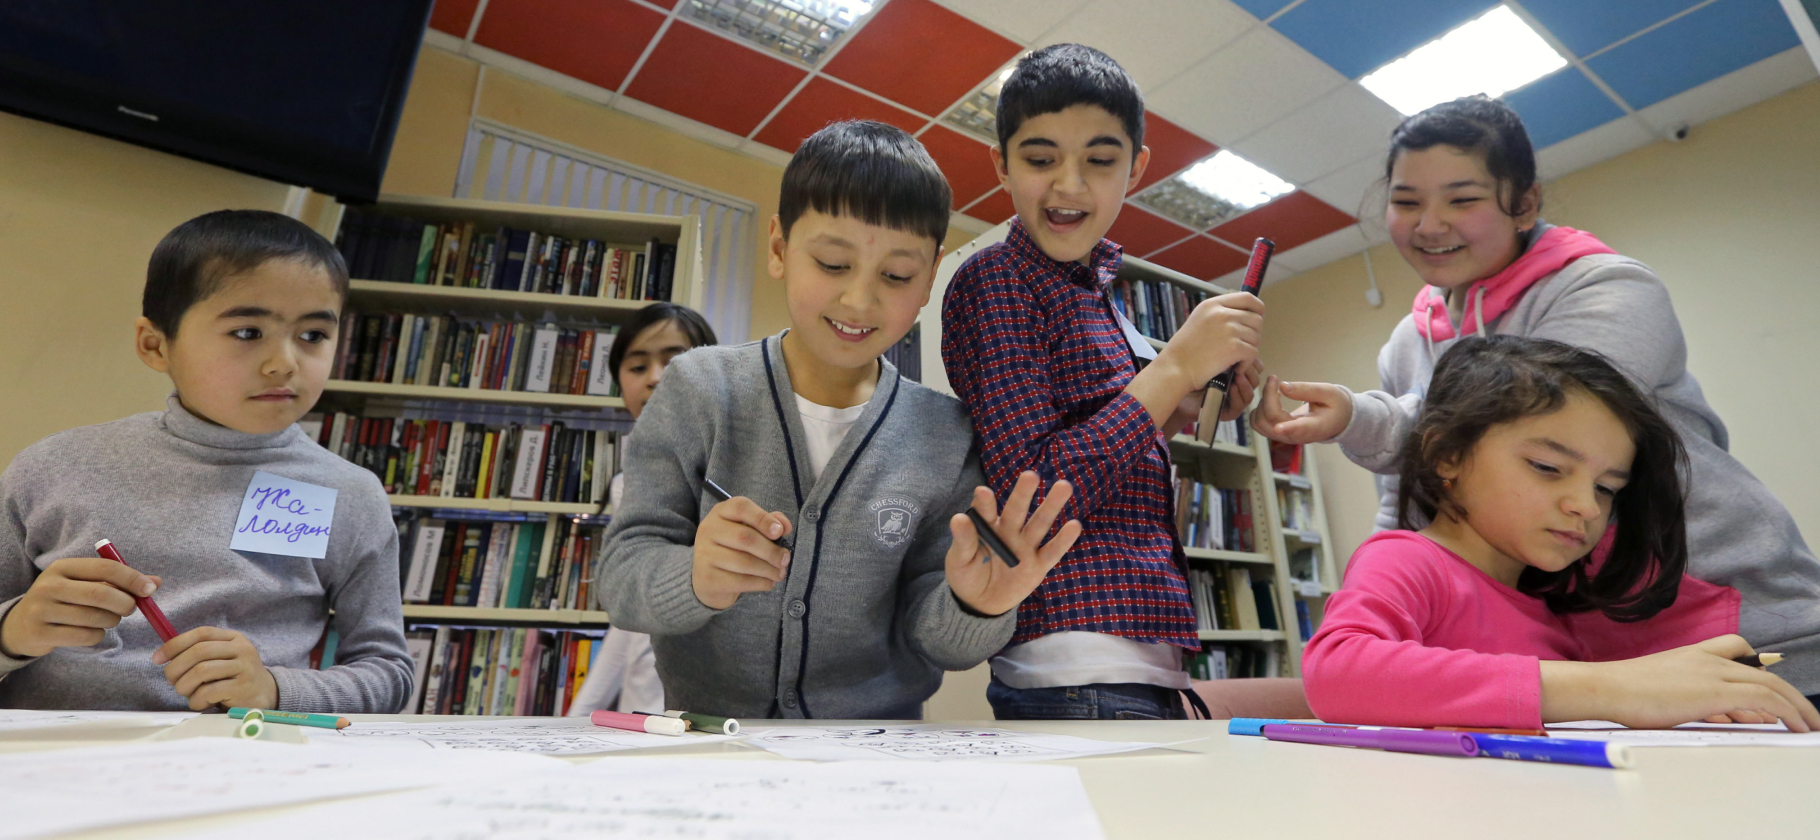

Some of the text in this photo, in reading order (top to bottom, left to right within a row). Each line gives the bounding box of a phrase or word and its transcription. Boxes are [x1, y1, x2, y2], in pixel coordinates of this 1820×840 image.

[536, 350, 547, 381] Лейкин
[597, 354, 609, 384] Леонов
[519, 445, 535, 494] Липскеров
[870, 497, 919, 515] CHESSFORD
